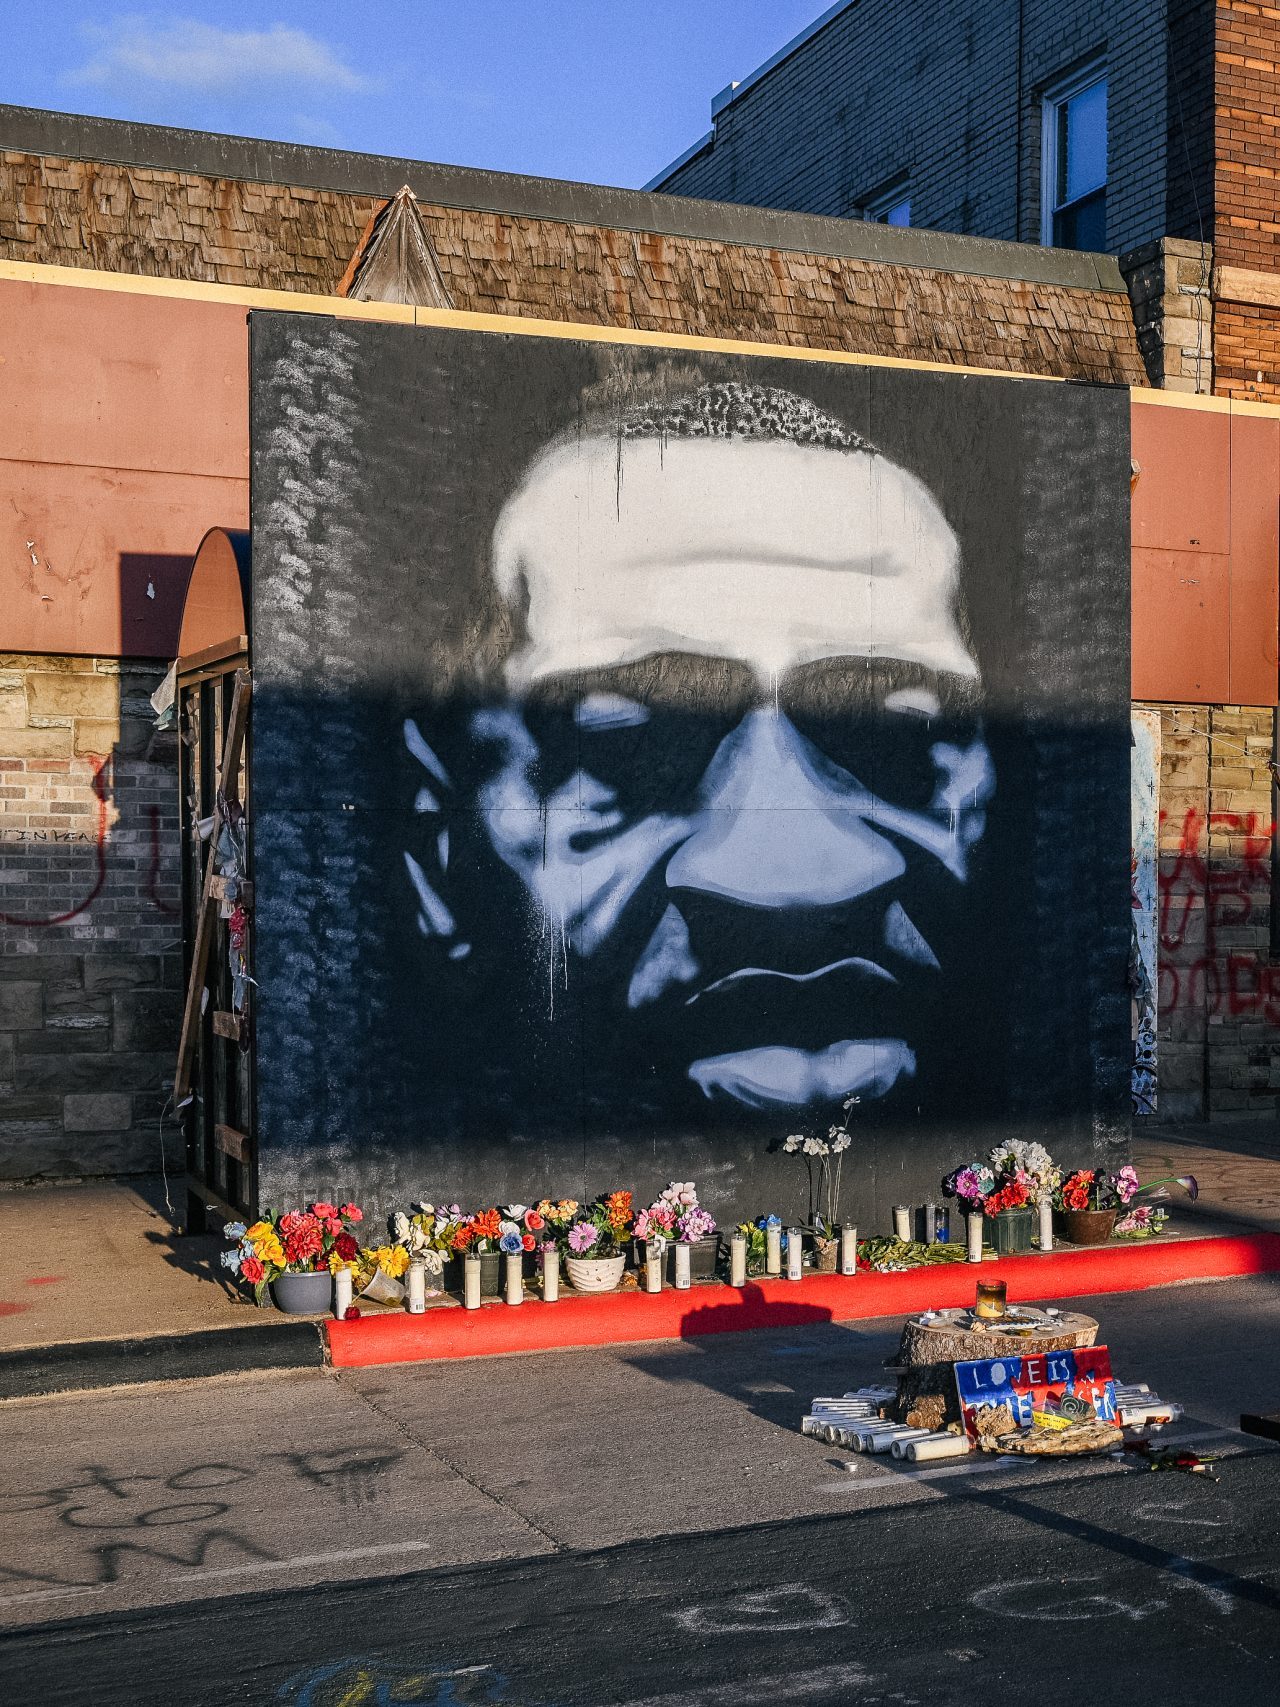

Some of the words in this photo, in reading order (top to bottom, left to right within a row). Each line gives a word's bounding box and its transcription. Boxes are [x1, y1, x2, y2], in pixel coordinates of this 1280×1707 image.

[1159, 808, 1276, 891] UCK
[1159, 888, 1251, 958] UP
[973, 1360, 1042, 1389] LOVE
[1047, 1358, 1070, 1382] IS
